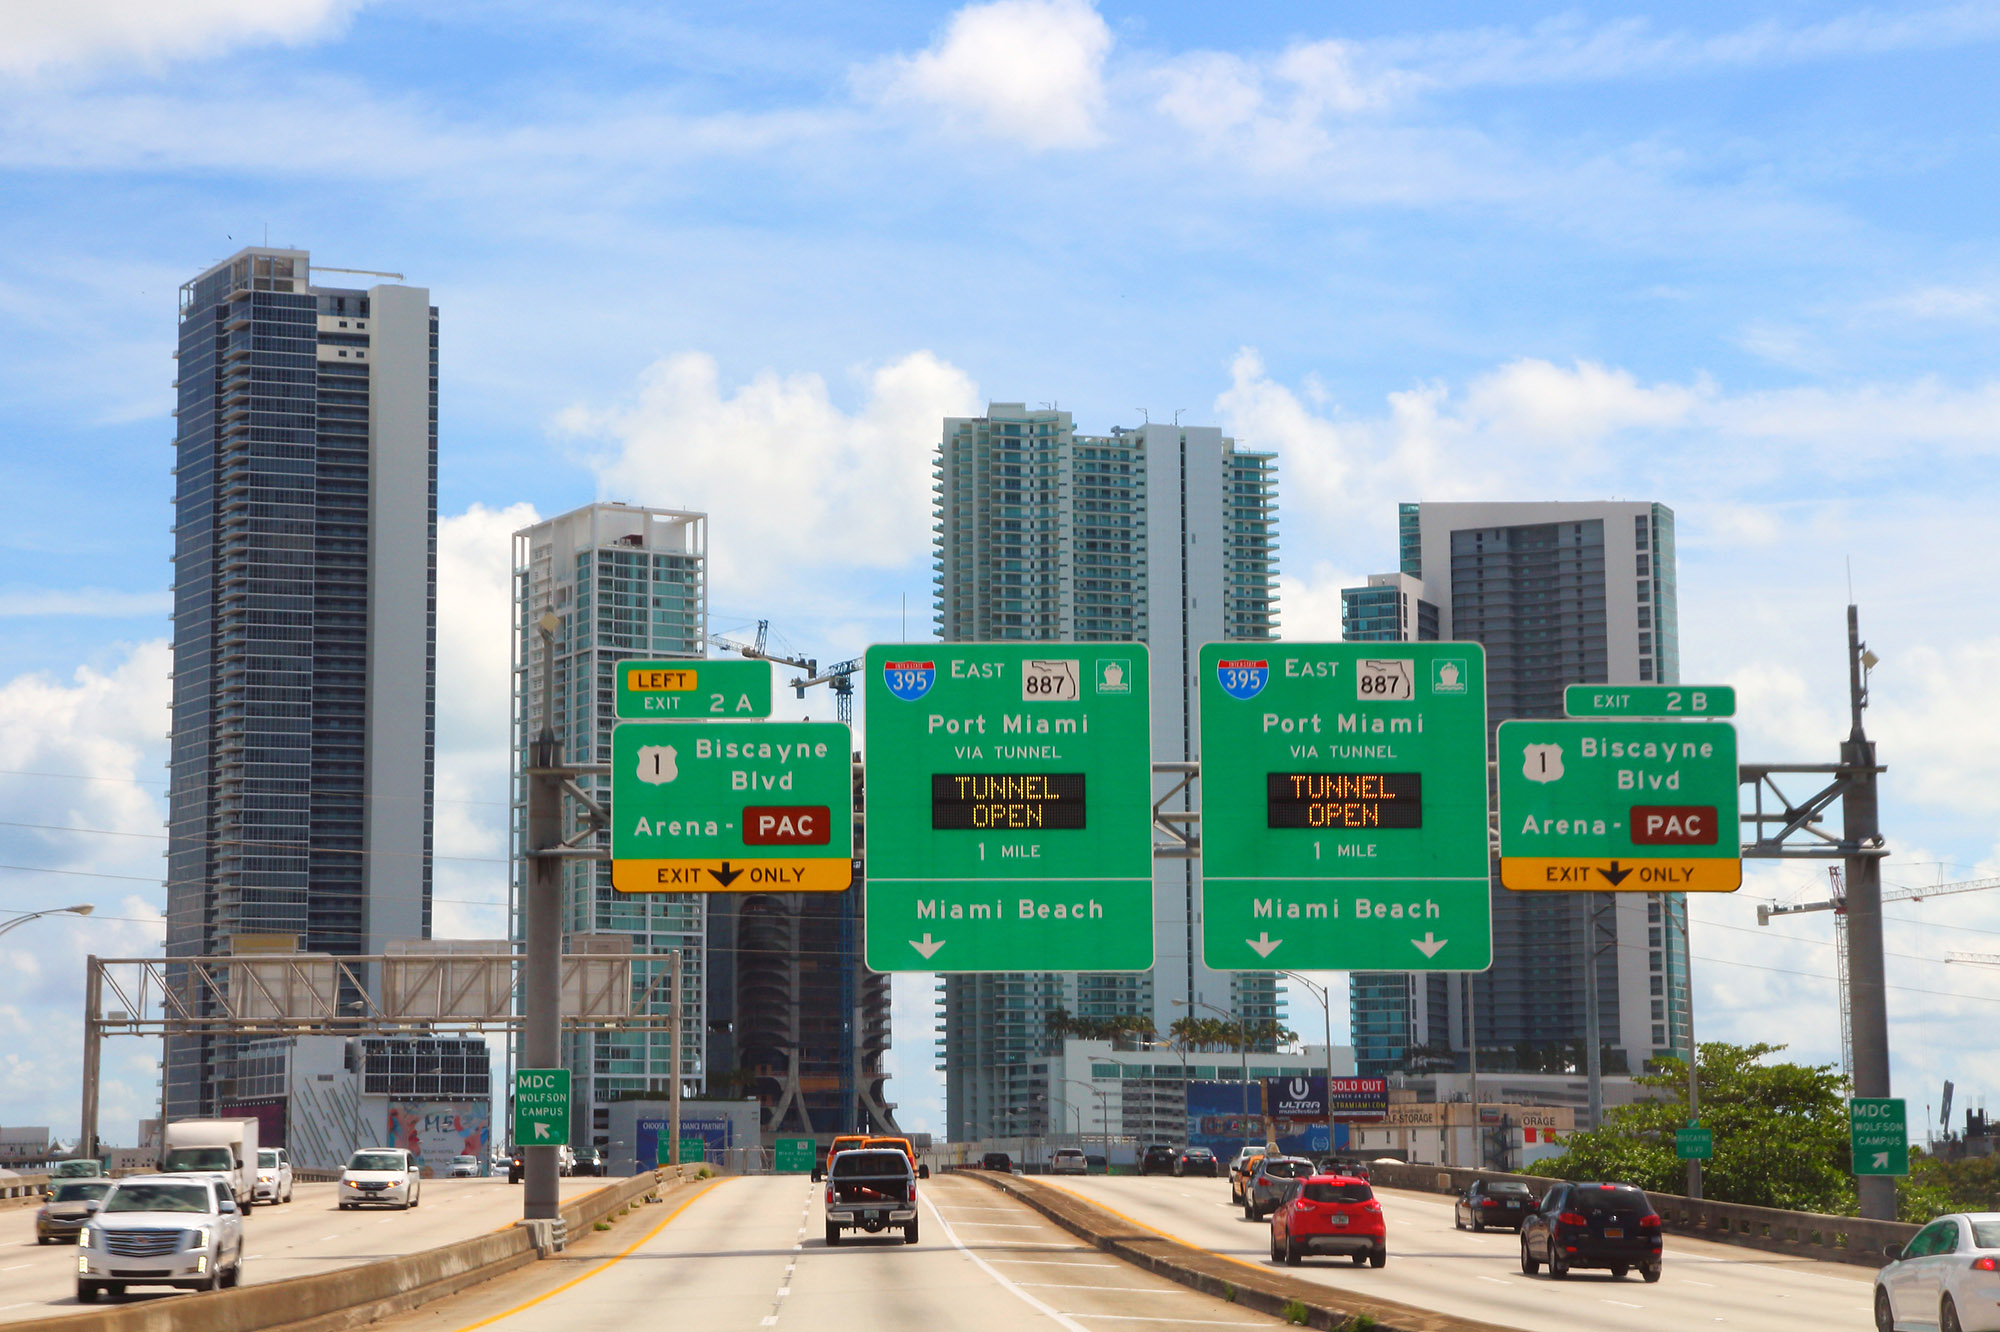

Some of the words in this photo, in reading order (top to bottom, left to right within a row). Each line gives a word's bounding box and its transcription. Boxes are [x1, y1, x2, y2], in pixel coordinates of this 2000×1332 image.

[952, 660, 1004, 678] EAST
[1286, 659, 1339, 676] EAST
[639, 673, 686, 687] LEFT
[893, 671, 927, 690] 395
[1027, 676, 1064, 694] 887
[1227, 670, 1260, 689] 395
[1361, 676, 1398, 693] 887
[645, 697, 680, 709] EXIT
[710, 694, 724, 712] 2
[736, 694, 752, 711] A
[1594, 695, 1630, 707] EXIT
[1667, 692, 1681, 710] 2
[1692, 693, 1707, 710] B
[929, 715, 985, 734] Port
[1004, 715, 1087, 733] Miami
[1264, 714, 1321, 733] Port
[1338, 714, 1422, 732] Miami
[697, 739, 827, 763] Biscayne
[955, 747, 983, 758] VIA
[995, 746, 1061, 758] TUNNEL
[1291, 745, 1318, 758] VIA
[1330, 746, 1396, 758] TUNNEL
[1582, 738, 1712, 762] Biscayne
[655, 754, 659, 774] 1
[1540, 752, 1545, 772] 1
[732, 771, 792, 790] Blvd
[955, 776, 1060, 800] TUNNEL
[1290, 775, 1396, 799] TUNNEL
[1618, 770, 1679, 789] Blvd
[973, 805, 1043, 827] OPEN
[1308, 804, 1379, 827] OPEN
[760, 816, 812, 835] PAC
[1647, 815, 1700, 835] PAC
[979, 843, 984, 860] 1
[1002, 845, 1040, 857] MILE
[1314, 842, 1320, 859] 1
[1338, 845, 1376, 856] MILE
[658, 869, 700, 883] EXIT
[751, 868, 804, 882] ONLY
[1547, 867, 1590, 881] EXIT
[1640, 867, 1693, 882] ONLY
[918, 900, 1001, 918] Miami
[1019, 899, 1102, 918] Beach
[1254, 899, 1338, 918] Miami
[1356, 899, 1439, 918] Beach
[519, 1075, 554, 1088] MDC
[1332, 1080, 1358, 1092] SOLD
[1362, 1080, 1382, 1092] OUT
[519, 1093, 566, 1102] WOLFSON
[1279, 1101, 1320, 1109] ULTRA
[1332, 1102, 1386, 1110] LTRAMIAMI.COM
[522, 1108, 563, 1116] CAMPUS
[1854, 1104, 1890, 1118] MDC
[1856, 1122, 1904, 1132] WOLFSON
[1858, 1136, 1902, 1146] CAMPUS
